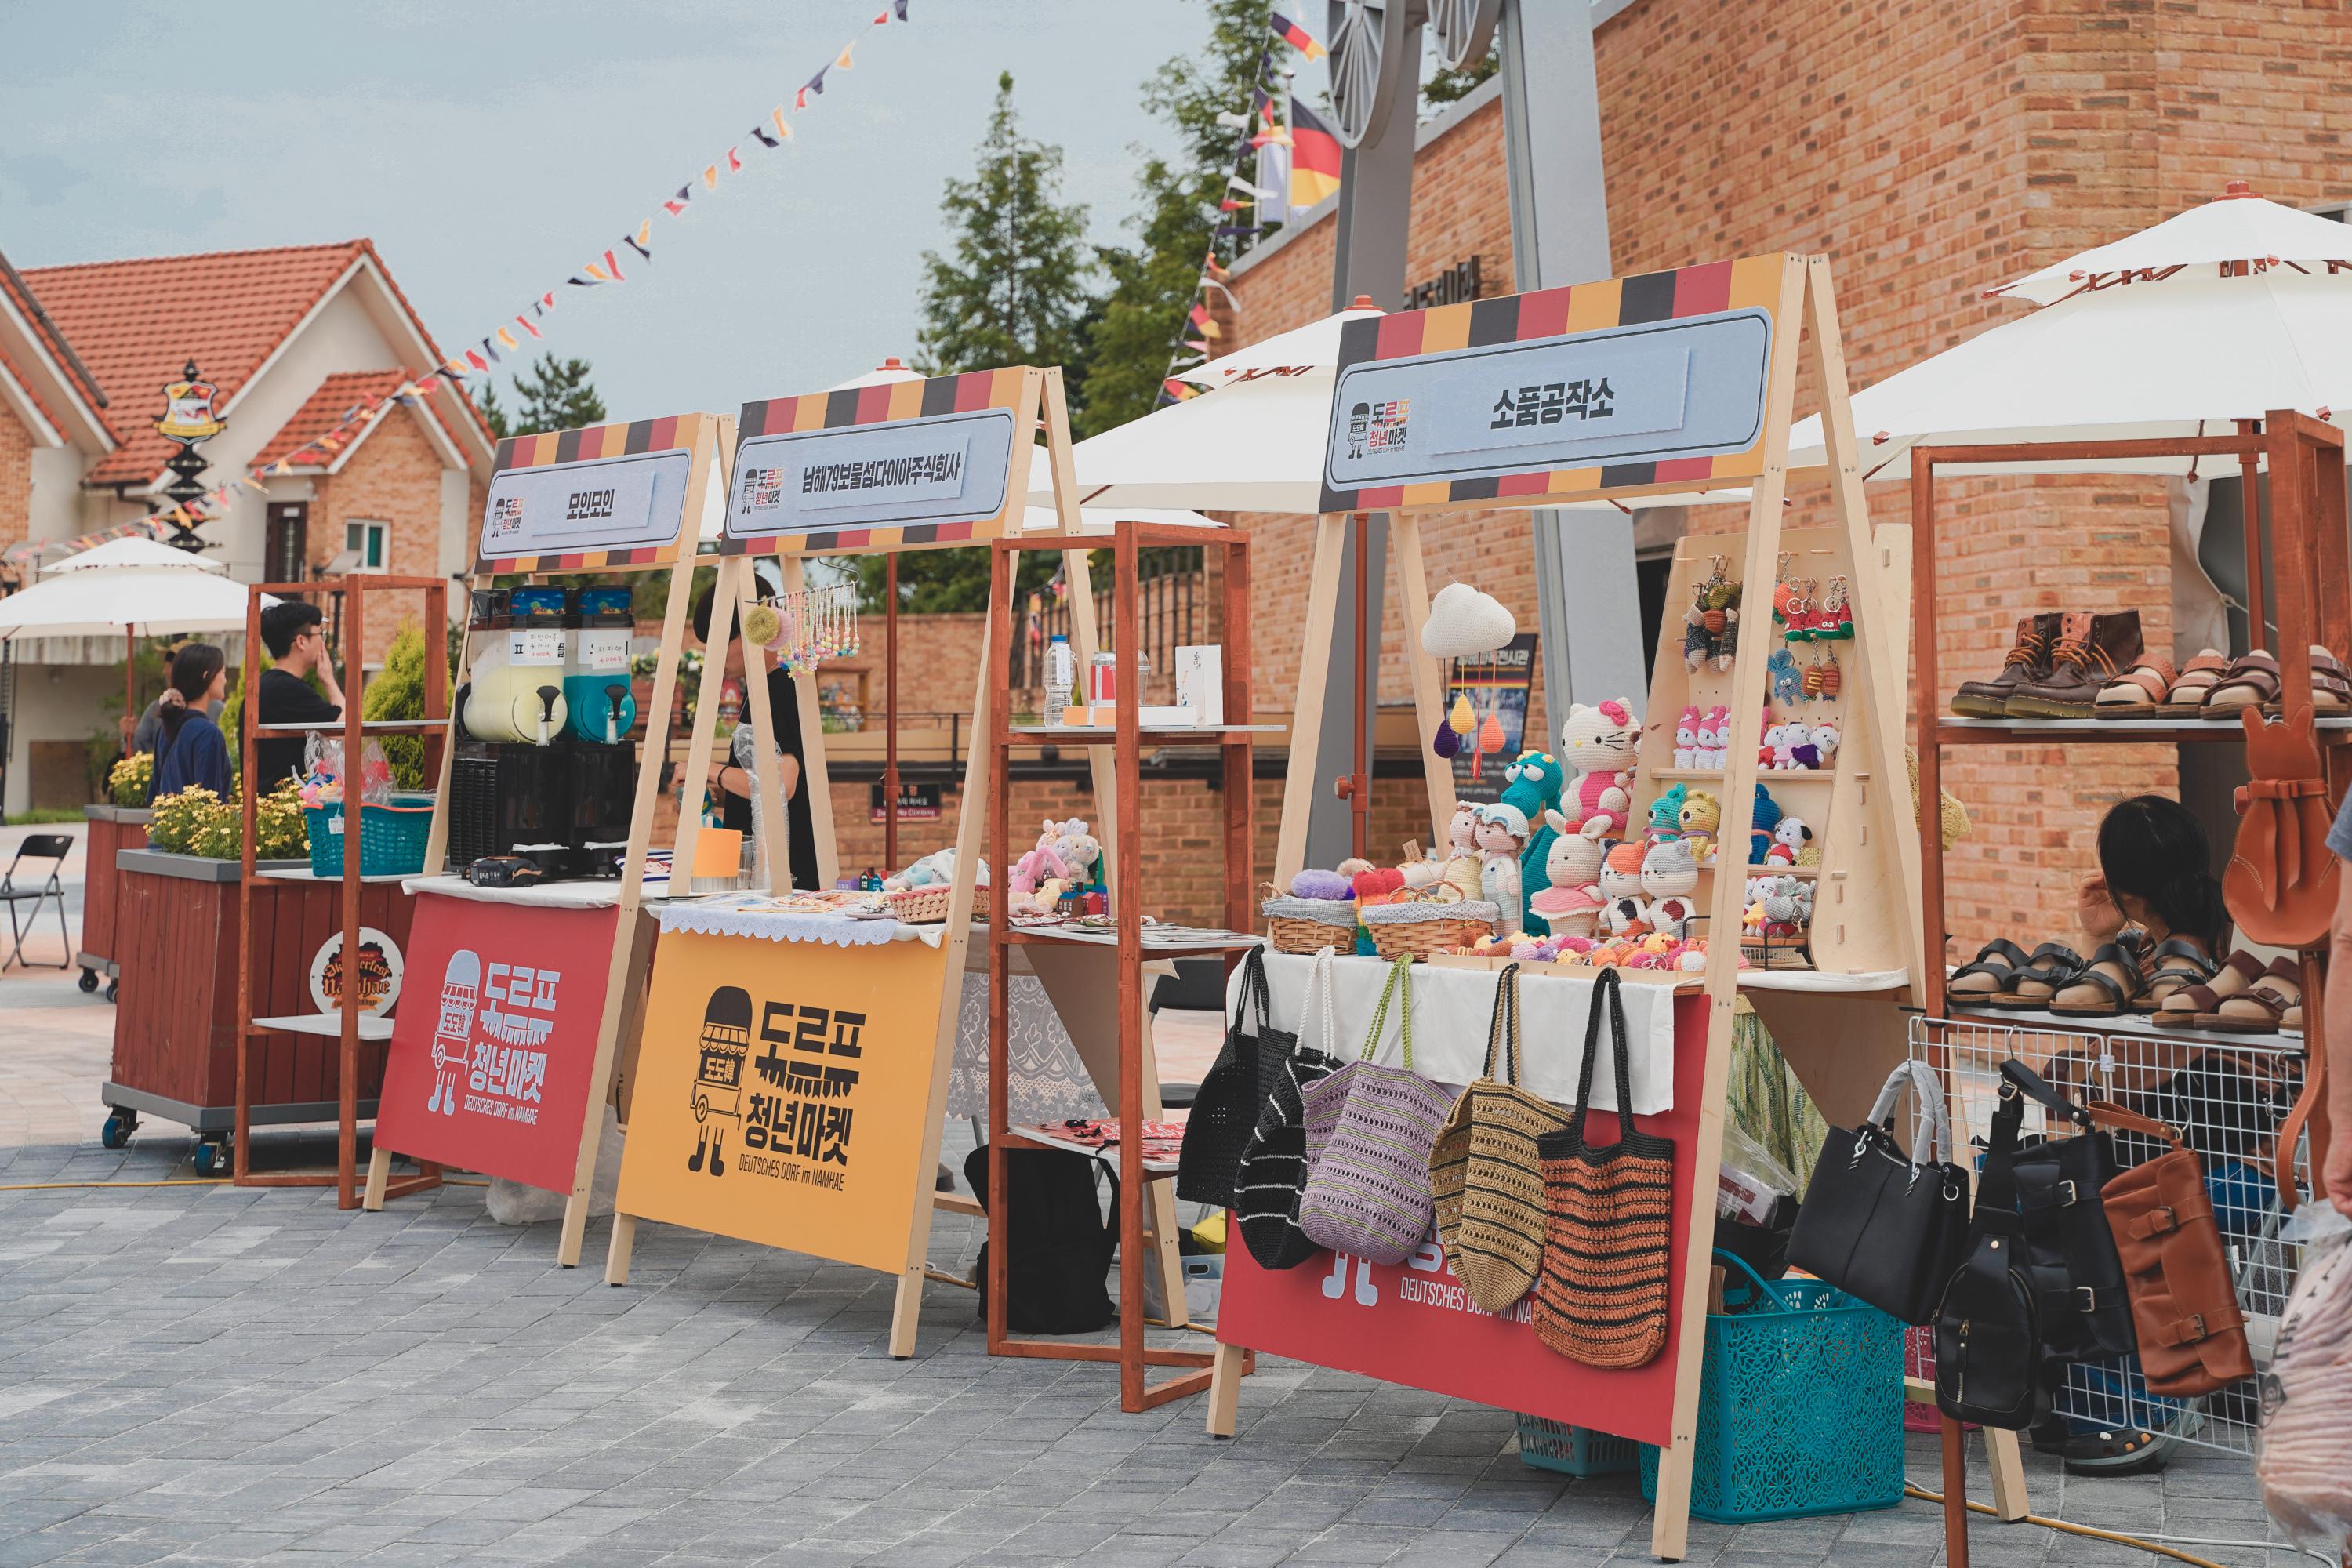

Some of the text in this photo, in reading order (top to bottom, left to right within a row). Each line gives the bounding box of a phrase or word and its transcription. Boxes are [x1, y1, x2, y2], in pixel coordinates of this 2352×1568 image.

[1490, 376, 1615, 430] 소품공작소
[1369, 427, 1407, 448] 청년마켓
[802, 452, 961, 494] 남해79보물섬다이아주식회사
[566, 489, 615, 520] 모인모인
[480, 963, 561, 1047] 도르프
[755, 1000, 866, 1099] 도르프
[470, 1042, 548, 1104] 청년마켓
[464, 1094, 494, 1116] DEUTSCHES
[493, 1100, 509, 1119] DORF
[514, 1105, 539, 1125] NAMHAE
[745, 1092, 854, 1167] 청년마켓
[739, 1153, 845, 1192] DEUTSCHES DORF im NAMHAE
[1400, 1276, 1465, 1312] DEUTSCHES
